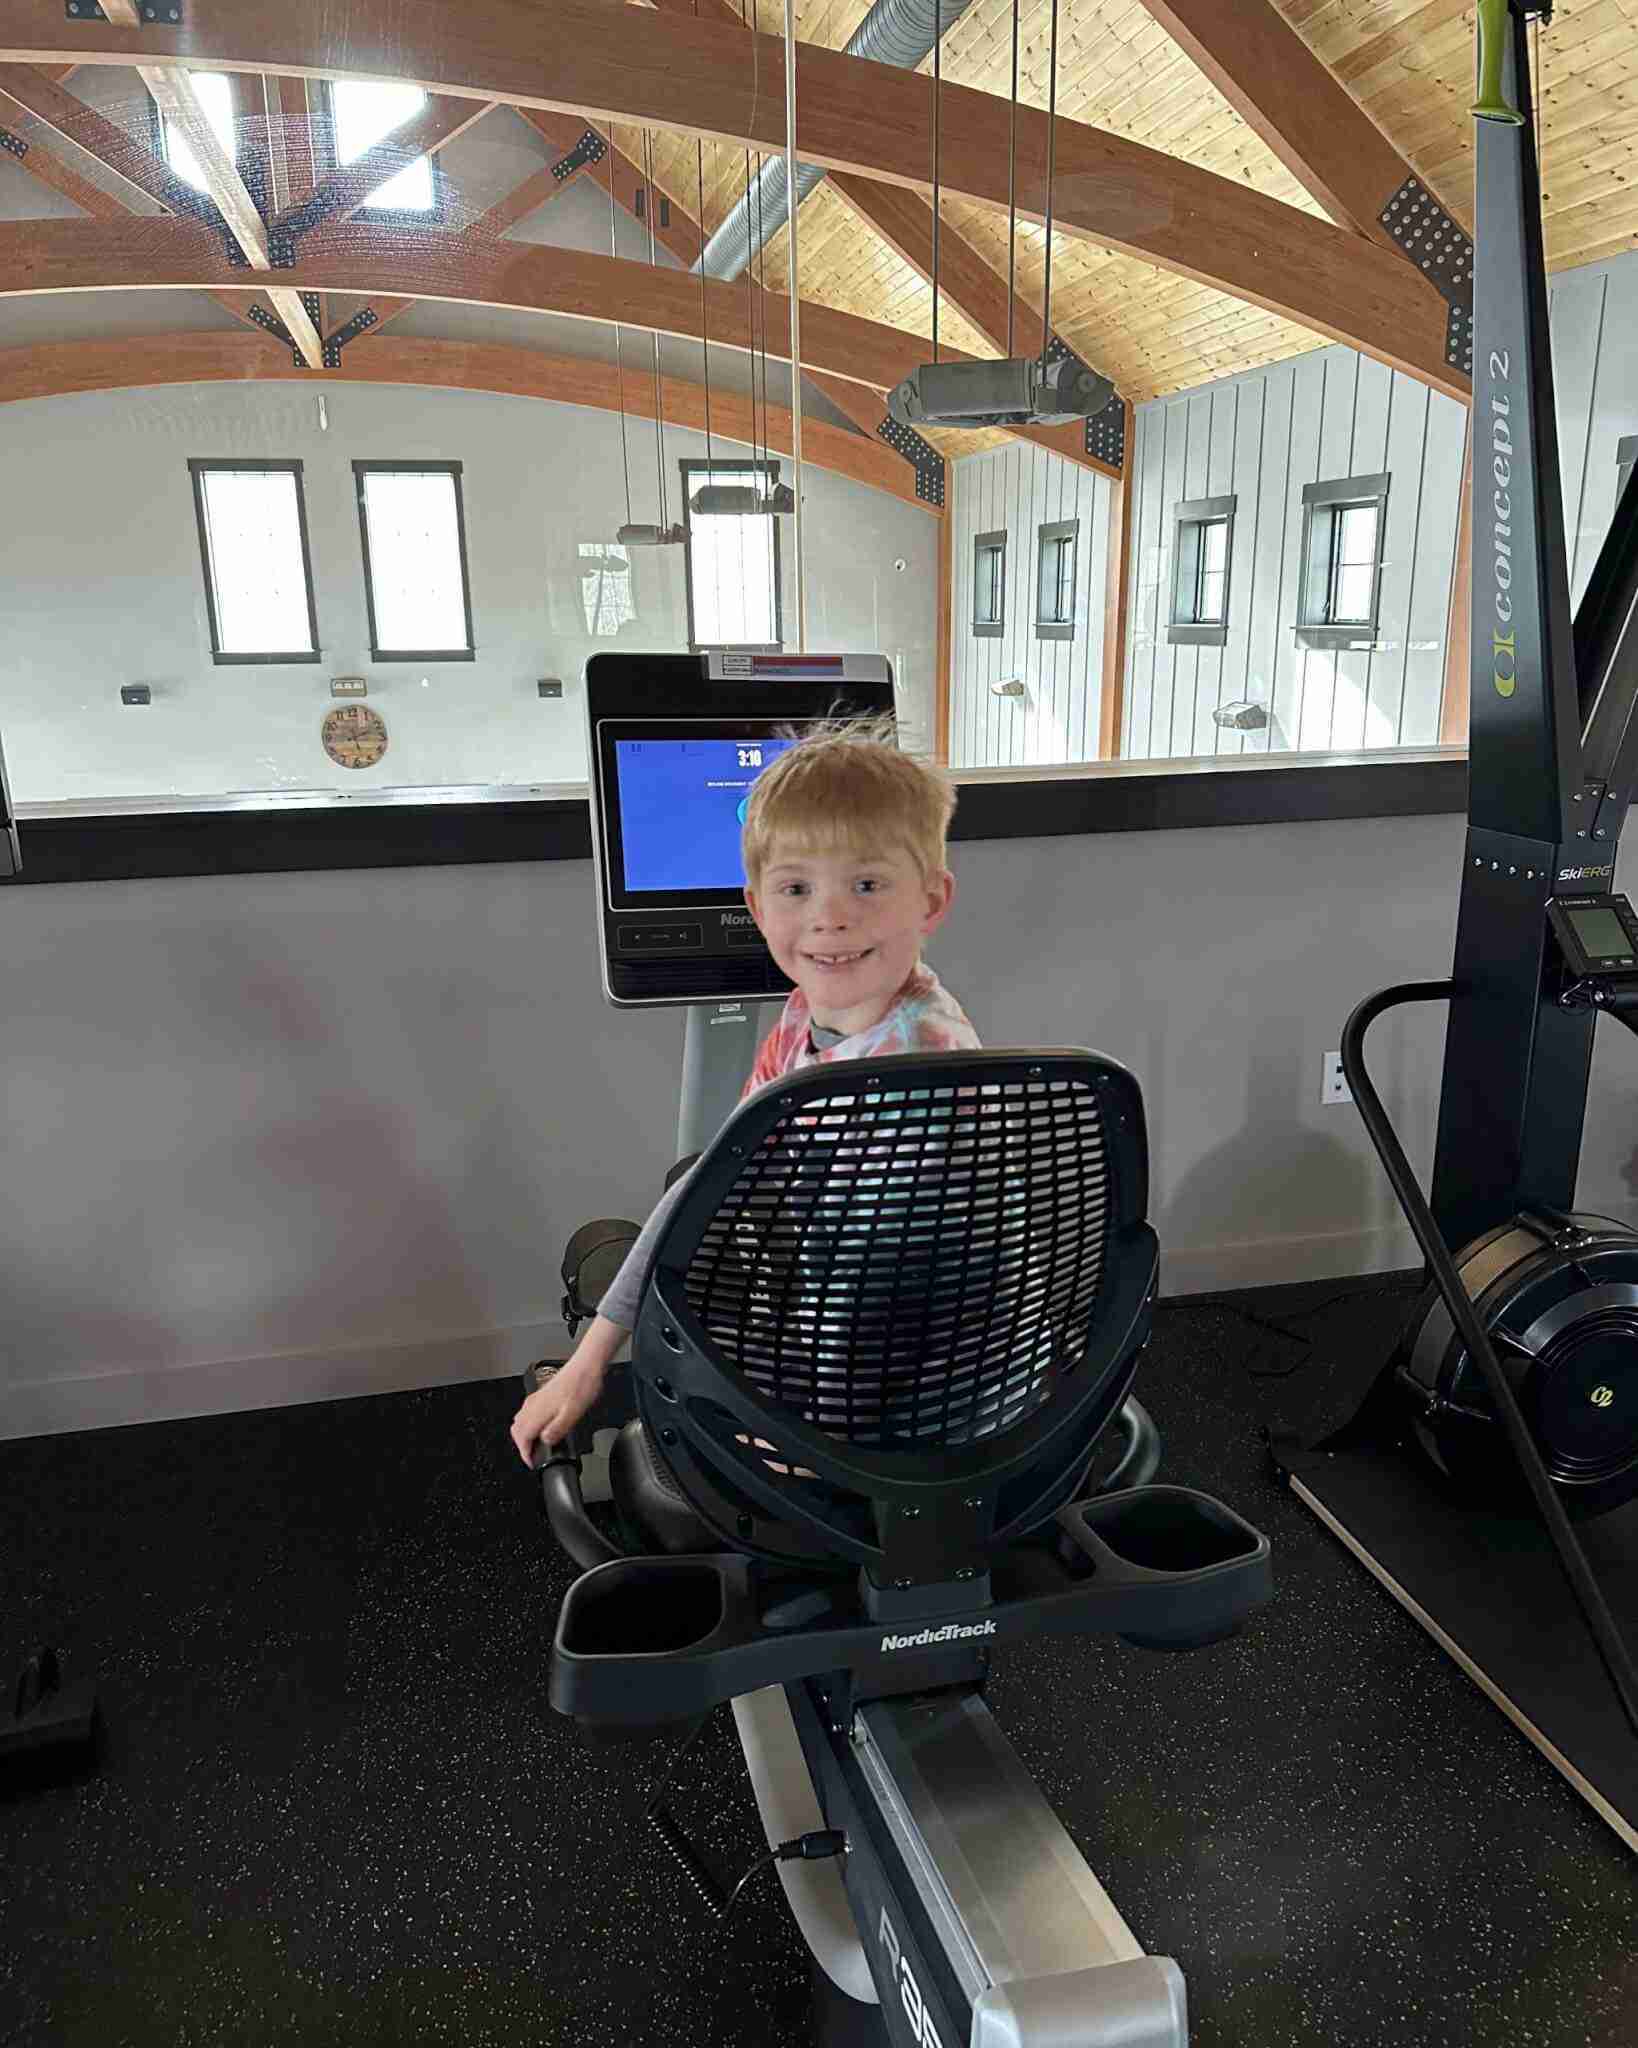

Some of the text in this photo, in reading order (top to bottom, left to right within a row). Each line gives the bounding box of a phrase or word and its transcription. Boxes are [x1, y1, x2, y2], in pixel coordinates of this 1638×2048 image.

[1488, 349, 1513, 622] concept 2
[738, 750, 762, 768] 3:10
[1558, 865, 1613, 881] SkiERG
[880, 1619, 998, 1653] NordicTrack
